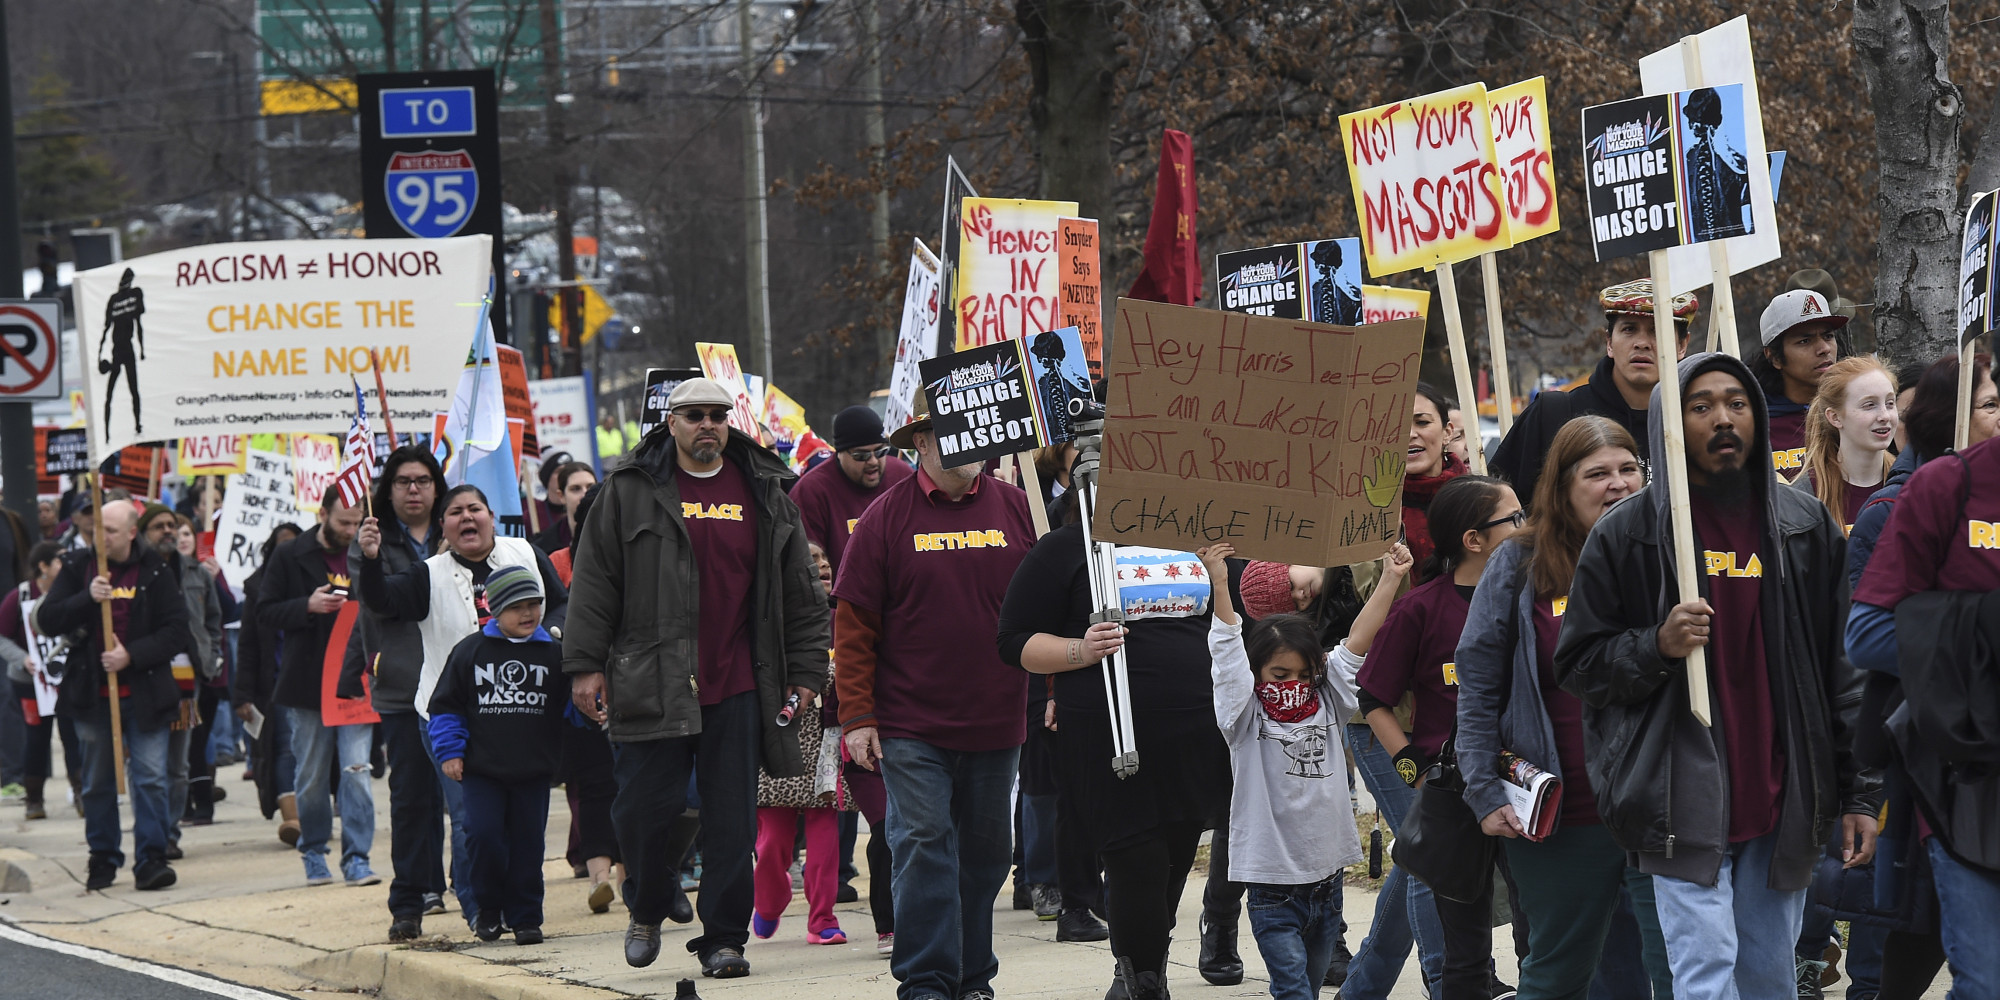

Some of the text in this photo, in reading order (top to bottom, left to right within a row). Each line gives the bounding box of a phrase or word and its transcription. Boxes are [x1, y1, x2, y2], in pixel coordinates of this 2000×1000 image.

[404, 98, 449, 126] TO
[1489, 95, 1536, 143] OUR
[1351, 101, 1479, 166] NOT YOUR
[1606, 126, 1644, 143] NOT YOUR
[1607, 137, 1645, 153] MASCOTS
[400, 155, 463, 169] INTERSTATE
[1592, 148, 1668, 187] CHANGE
[396, 175, 467, 226] 95
[1363, 158, 1502, 256] MASCOTS
[1613, 182, 1647, 210] THE
[962, 204, 993, 243] NO
[1594, 201, 1677, 243] MASCOT
[1064, 226, 1093, 252] Snyder
[176, 254, 287, 287] RACISM
[328, 251, 442, 278] HONOR
[1010, 258, 1047, 293] IN
[1072, 255, 1091, 281] Says
[1241, 275, 1277, 285] MASCOTS
[1256, 266, 1276, 277] YOUR
[1226, 281, 1297, 309] CHANGE
[207, 300, 415, 333] CHANGE THE
[1246, 304, 1275, 318] THE
[1083, 315, 1096, 343] Say
[213, 345, 411, 378] NAME NOW!
[1123, 308, 1420, 389] Hey Harris Teeter
[952, 365, 994, 382] NOT YOUR
[953, 373, 996, 389] MASCOTS
[935, 378, 1021, 416] CHANGE
[1110, 372, 1157, 418] I
[1167, 394, 1200, 423] am
[1211, 400, 1227, 424] a
[1348, 393, 1407, 444] Child
[964, 405, 1001, 429] THE
[181, 433, 242, 459] NAME
[939, 416, 1035, 456] MASCOT
[252, 454, 279, 472] THEY
[1106, 430, 1178, 474] NOT
[1178, 449, 1200, 480] a
[243, 492, 269, 510] HOME
[681, 502, 743, 521] EPLACE
[1110, 495, 1396, 547] CHANGE THE NAME
[913, 529, 1008, 552] RETHINK
[1703, 550, 1763, 577] EPLA
[474, 660, 549, 687] NOT
[478, 690, 548, 706] MASCOT
[479, 706, 545, 715] #notyourmasco
